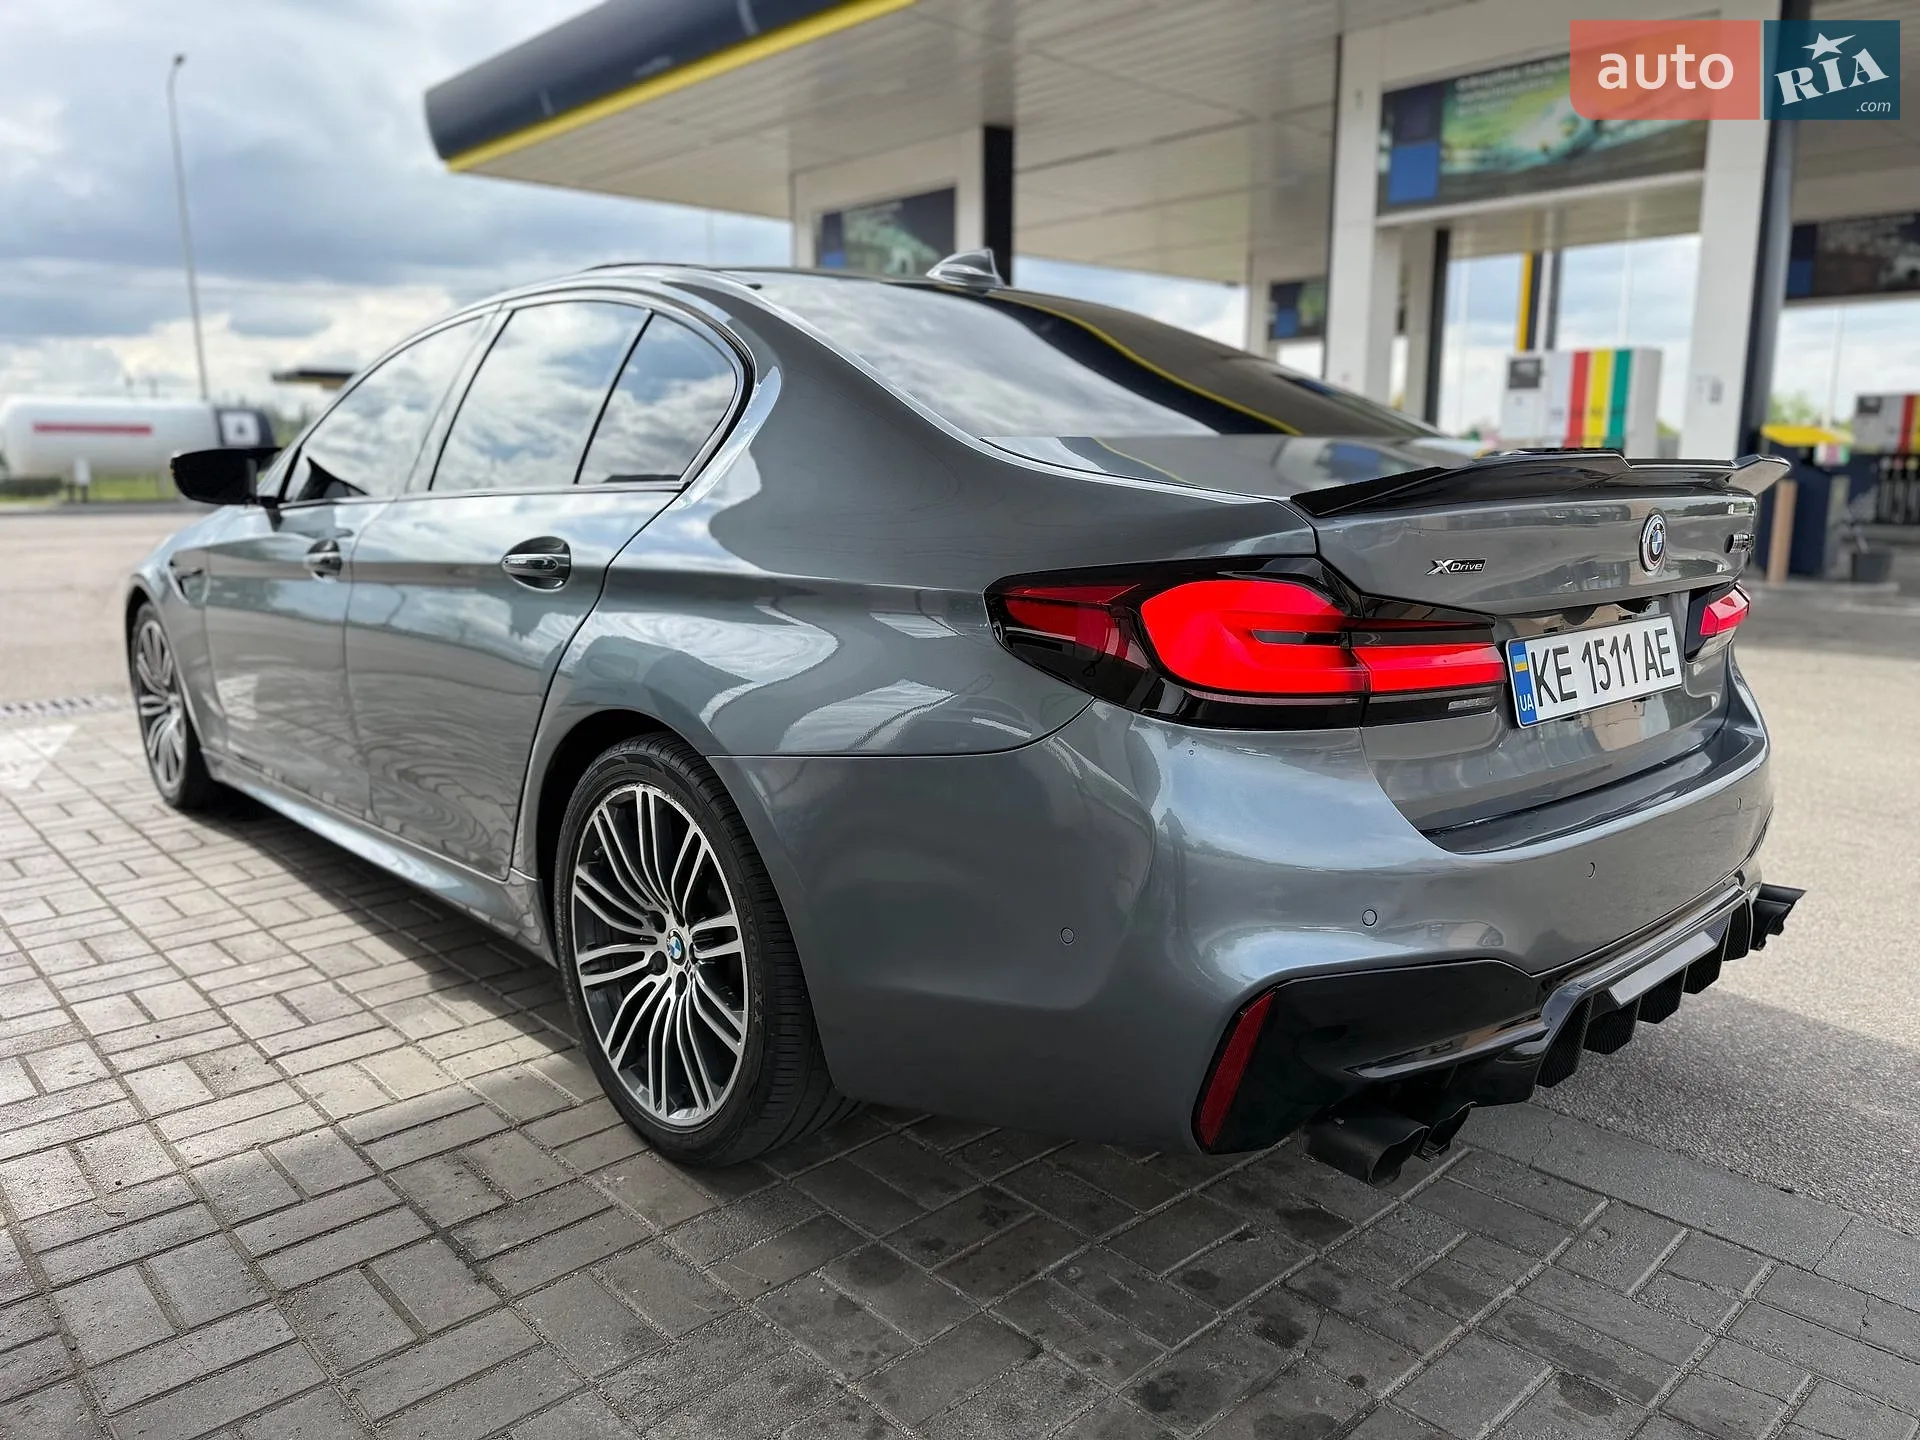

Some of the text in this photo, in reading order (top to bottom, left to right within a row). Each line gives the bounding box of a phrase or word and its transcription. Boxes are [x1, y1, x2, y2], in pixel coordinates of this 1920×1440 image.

[1530, 628, 1675, 707] KE 1511 AE
[1519, 693, 1535, 712] UA
